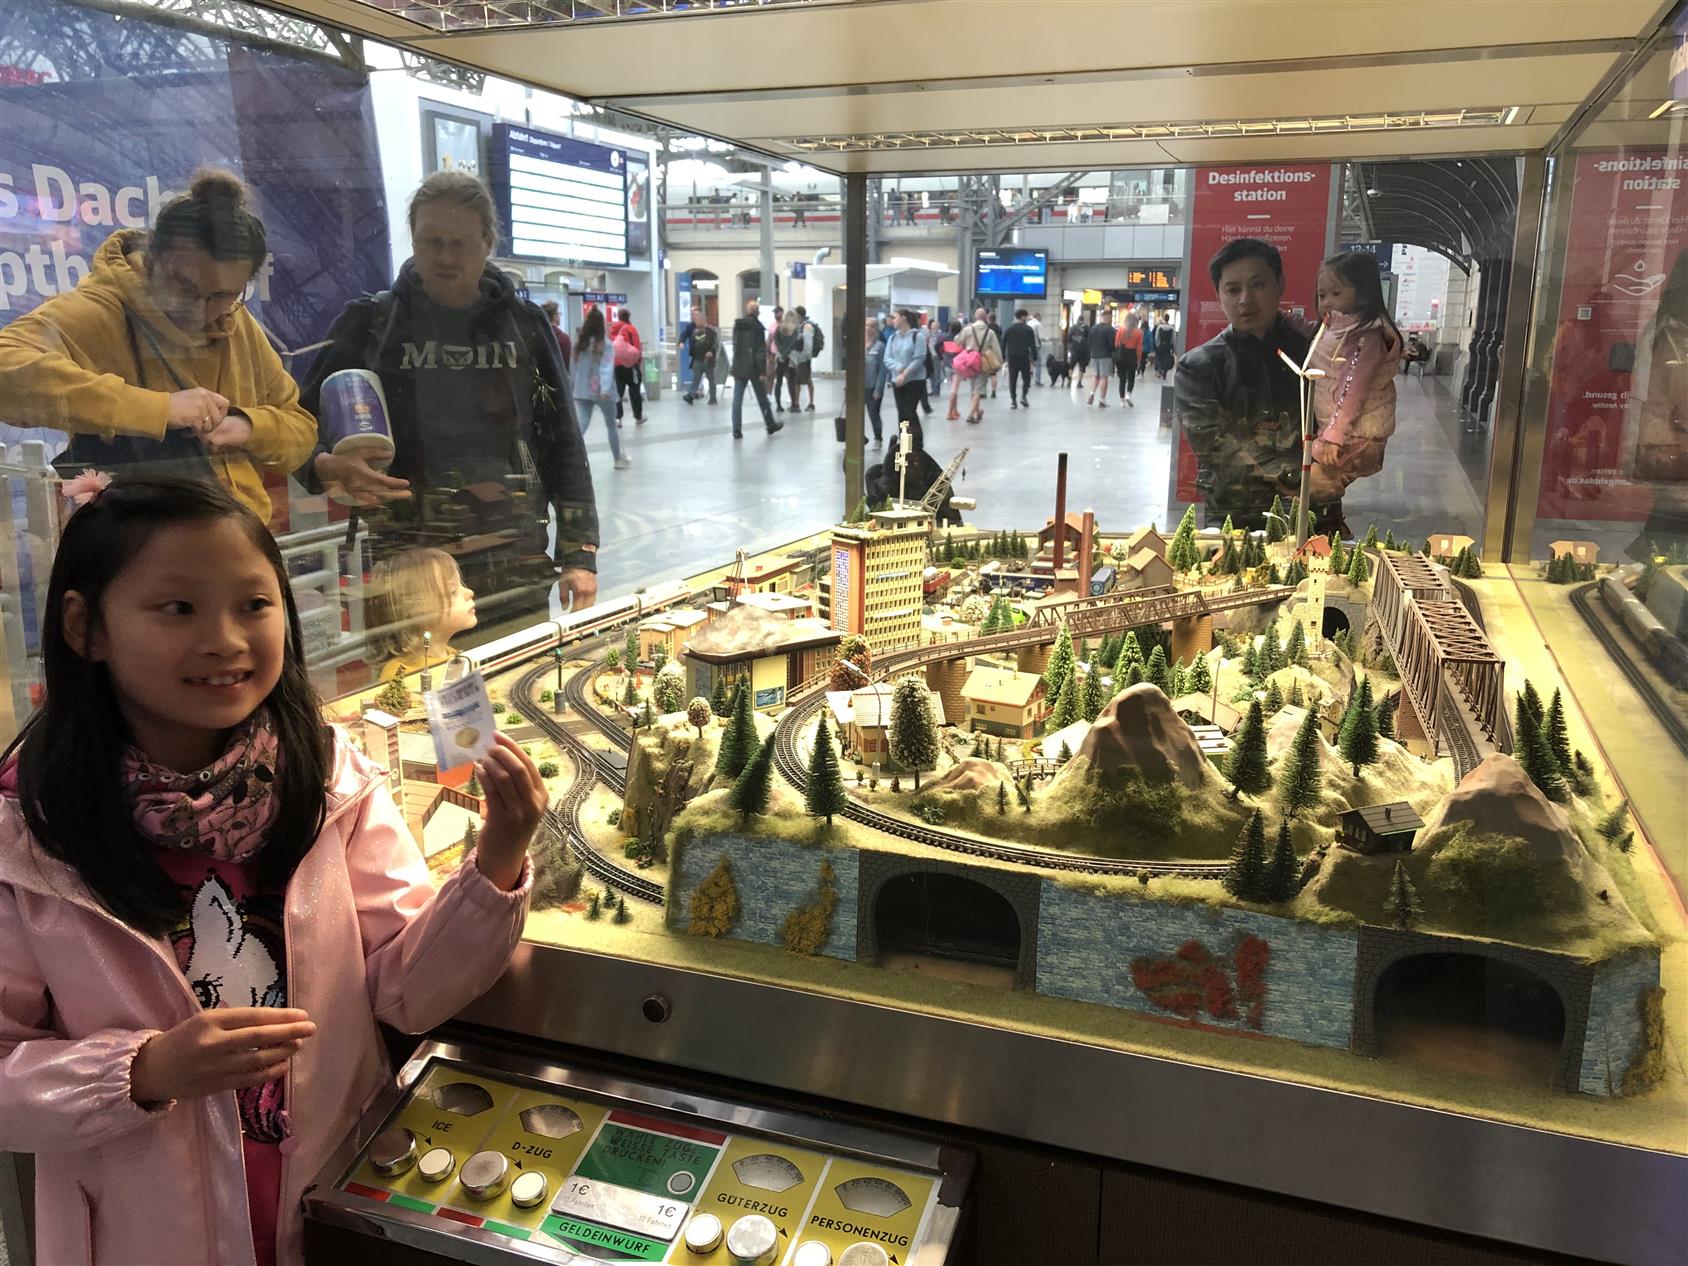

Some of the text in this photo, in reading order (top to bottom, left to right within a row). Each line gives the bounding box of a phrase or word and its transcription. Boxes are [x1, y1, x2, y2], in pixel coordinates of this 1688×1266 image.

[1208, 169, 1316, 185] Desinfektions-
[1234, 188, 1287, 202] station
[1221, 225, 1236, 233] Hier
[1263, 225, 1273, 233] du
[1274, 224, 1295, 233] deine
[432, 1120, 453, 1132] ICE
[511, 1141, 553, 1159] D-ZUG
[610, 1135, 701, 1165] WEISSE TASTE
[571, 1183, 590, 1195] 1€
[657, 1204, 676, 1217] 1€
[717, 1192, 789, 1218] GÜTERZUG
[559, 1221, 651, 1253] GELDEINWURF
[811, 1215, 909, 1246] PERSONENZUG
